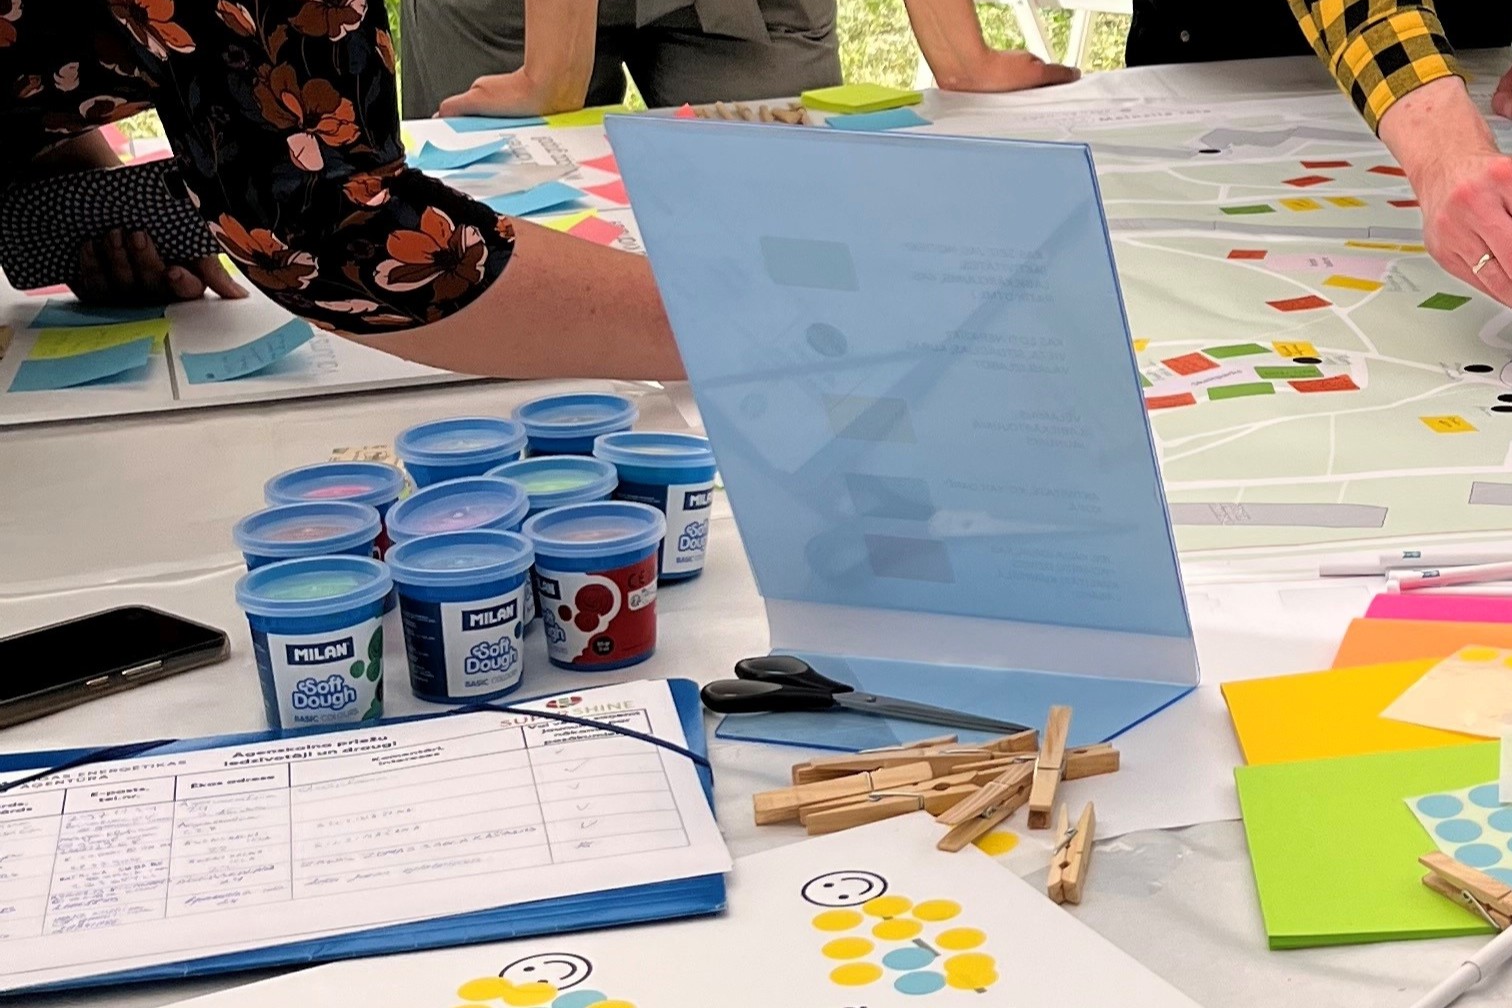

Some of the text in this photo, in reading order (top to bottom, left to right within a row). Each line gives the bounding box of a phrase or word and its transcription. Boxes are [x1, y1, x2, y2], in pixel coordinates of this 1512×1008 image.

[469, 604, 516, 628] MILAN
[294, 642, 348, 662] MILAN
[470, 636, 511, 660] Soft
[465, 646, 518, 675] Dough
[297, 674, 345, 695] Soft
[292, 685, 357, 711] Dough
[294, 715, 319, 723] BASIC
